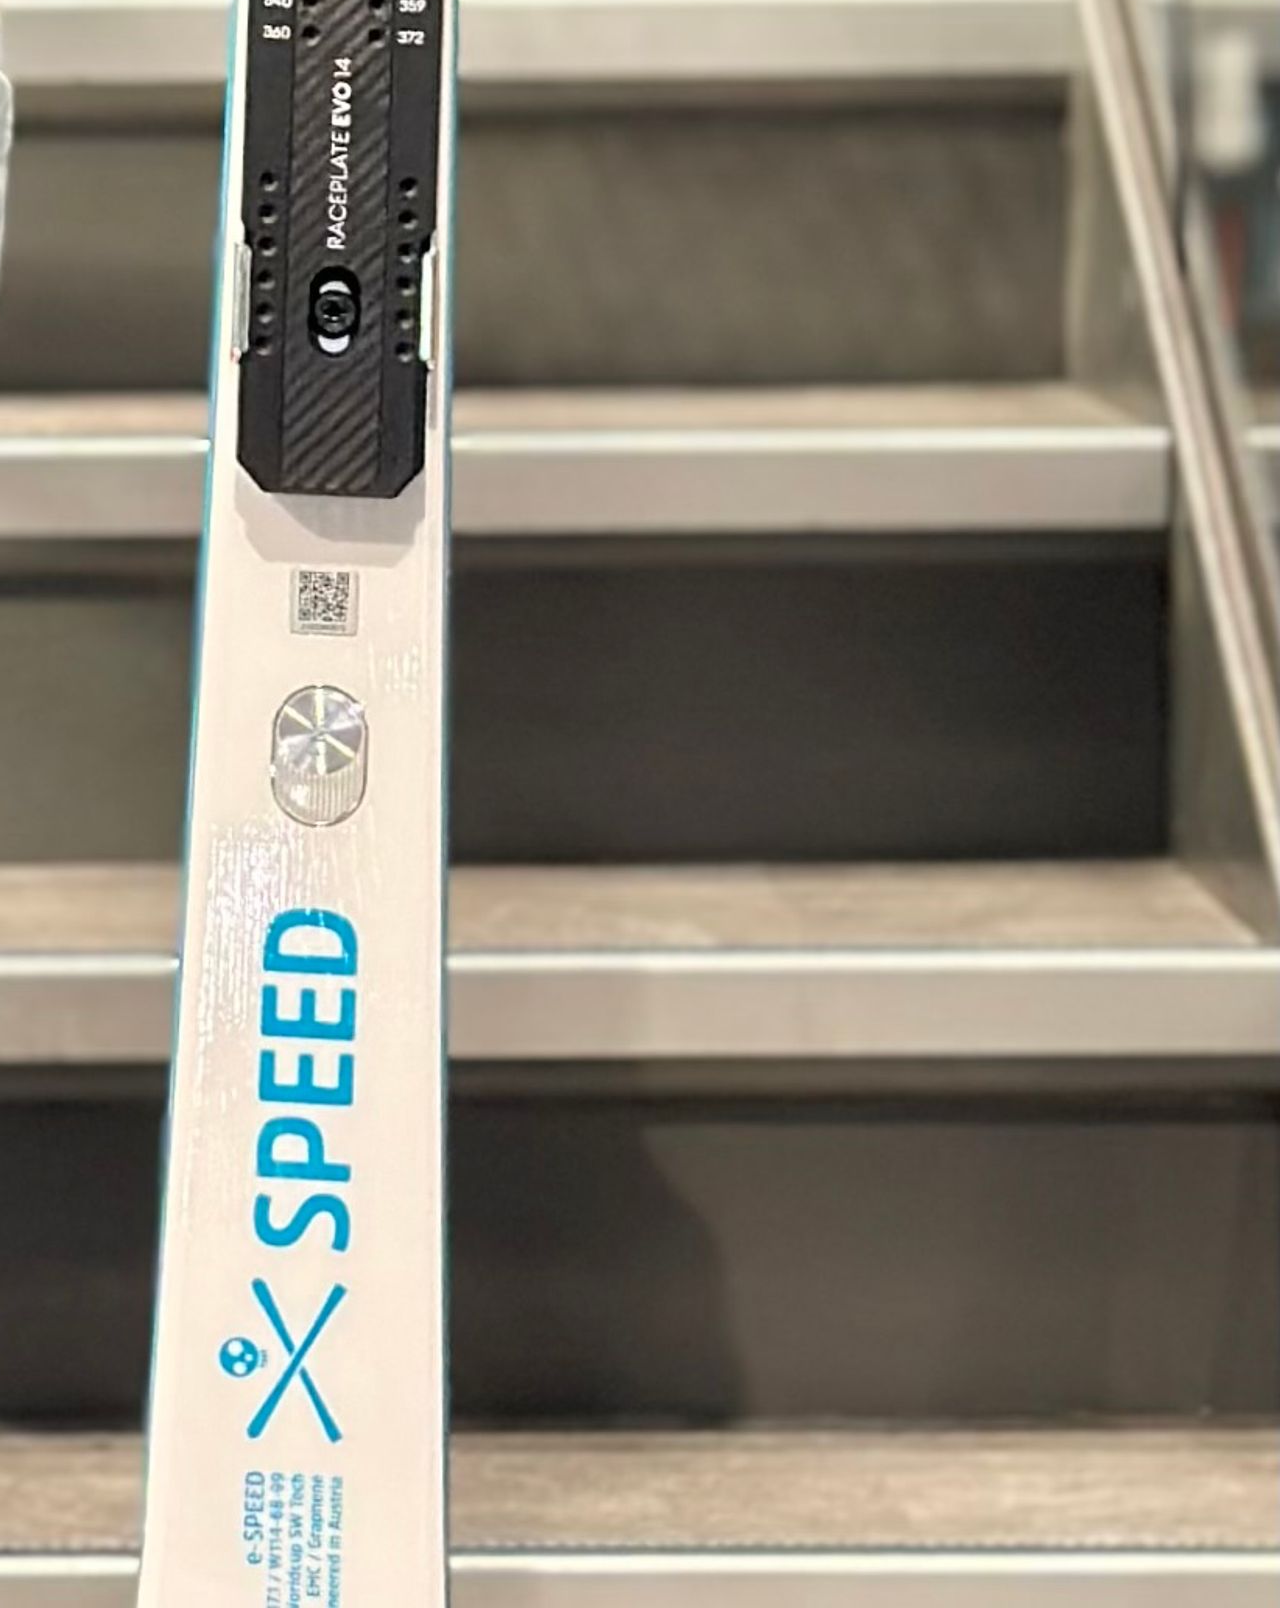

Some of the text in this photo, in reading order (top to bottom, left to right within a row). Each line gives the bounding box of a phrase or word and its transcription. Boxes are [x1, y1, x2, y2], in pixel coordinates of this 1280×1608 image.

[262, 24, 291, 40] 360
[396, 30, 425, 45] 372
[326, 56, 352, 250] RACEPLATE EVO 14
[253, 907, 358, 1253] SPEED
[289, 1473, 304, 1507] Tech
[327, 1475, 343, 1530] Austria
[243, 1470, 266, 1565] e-SPEED
[288, 1512, 303, 1538] SW
